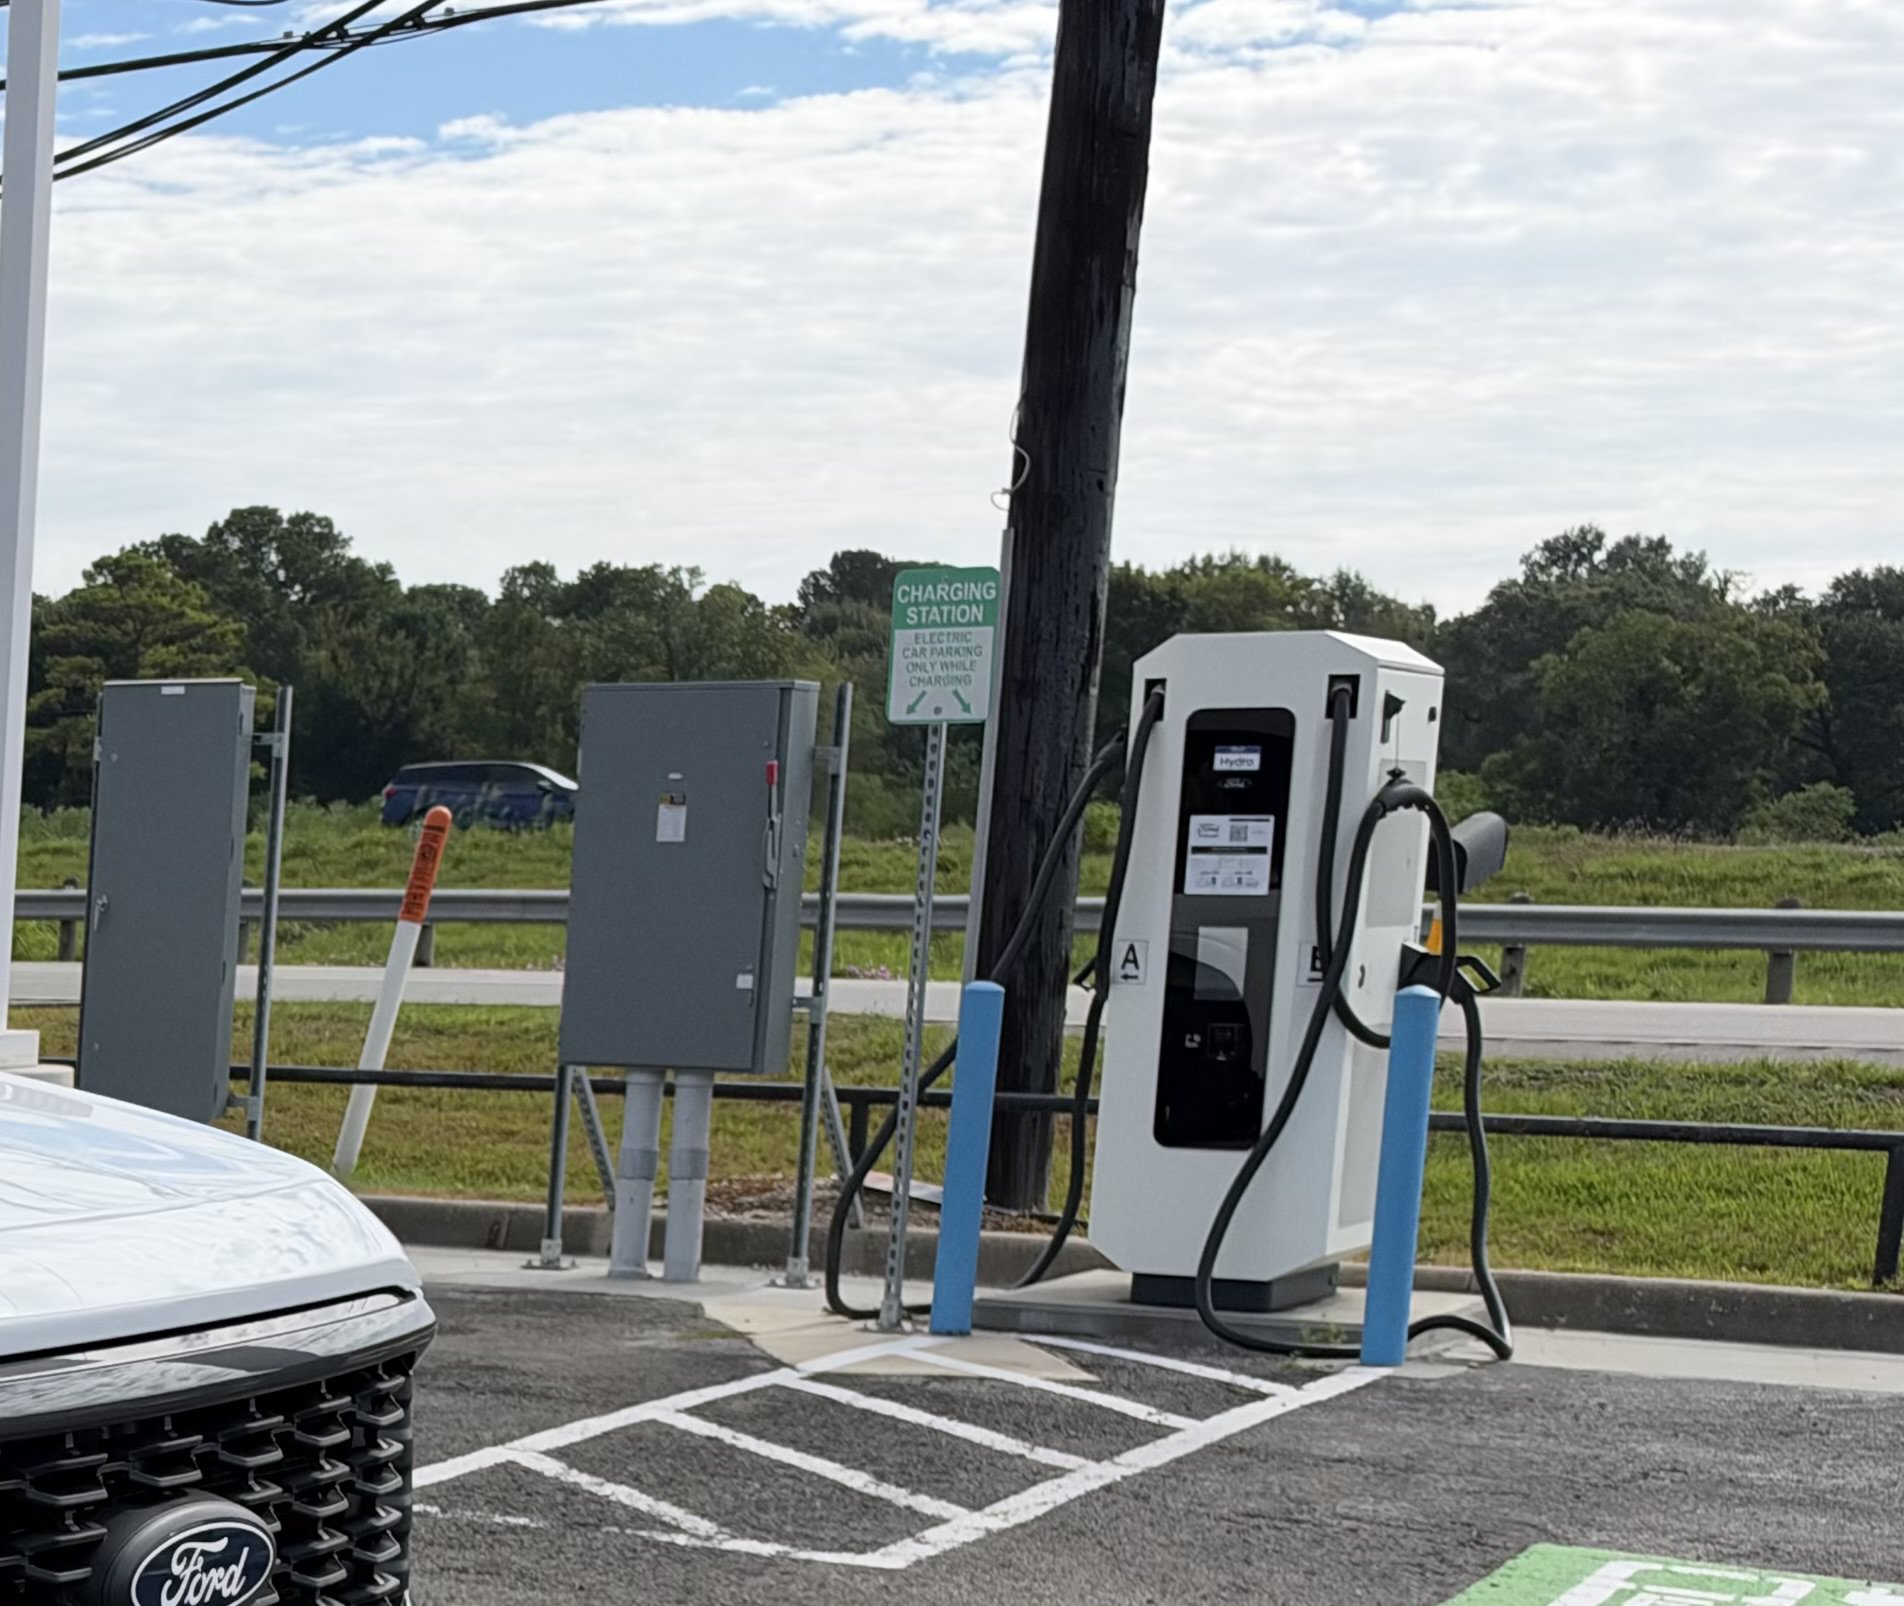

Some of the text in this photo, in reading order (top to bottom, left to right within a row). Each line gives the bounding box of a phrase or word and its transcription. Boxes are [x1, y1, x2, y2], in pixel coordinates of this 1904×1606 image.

[897, 582, 996, 603] CHARGING
[906, 604, 984, 624] STATION
[914, 631, 973, 645] ELECTRIC
[902, 645, 983, 659] CAR PARKING
[906, 660, 977, 673] ONLY WHILE
[909, 674, 972, 687] CHARGING
[1121, 943, 1140, 970] A
